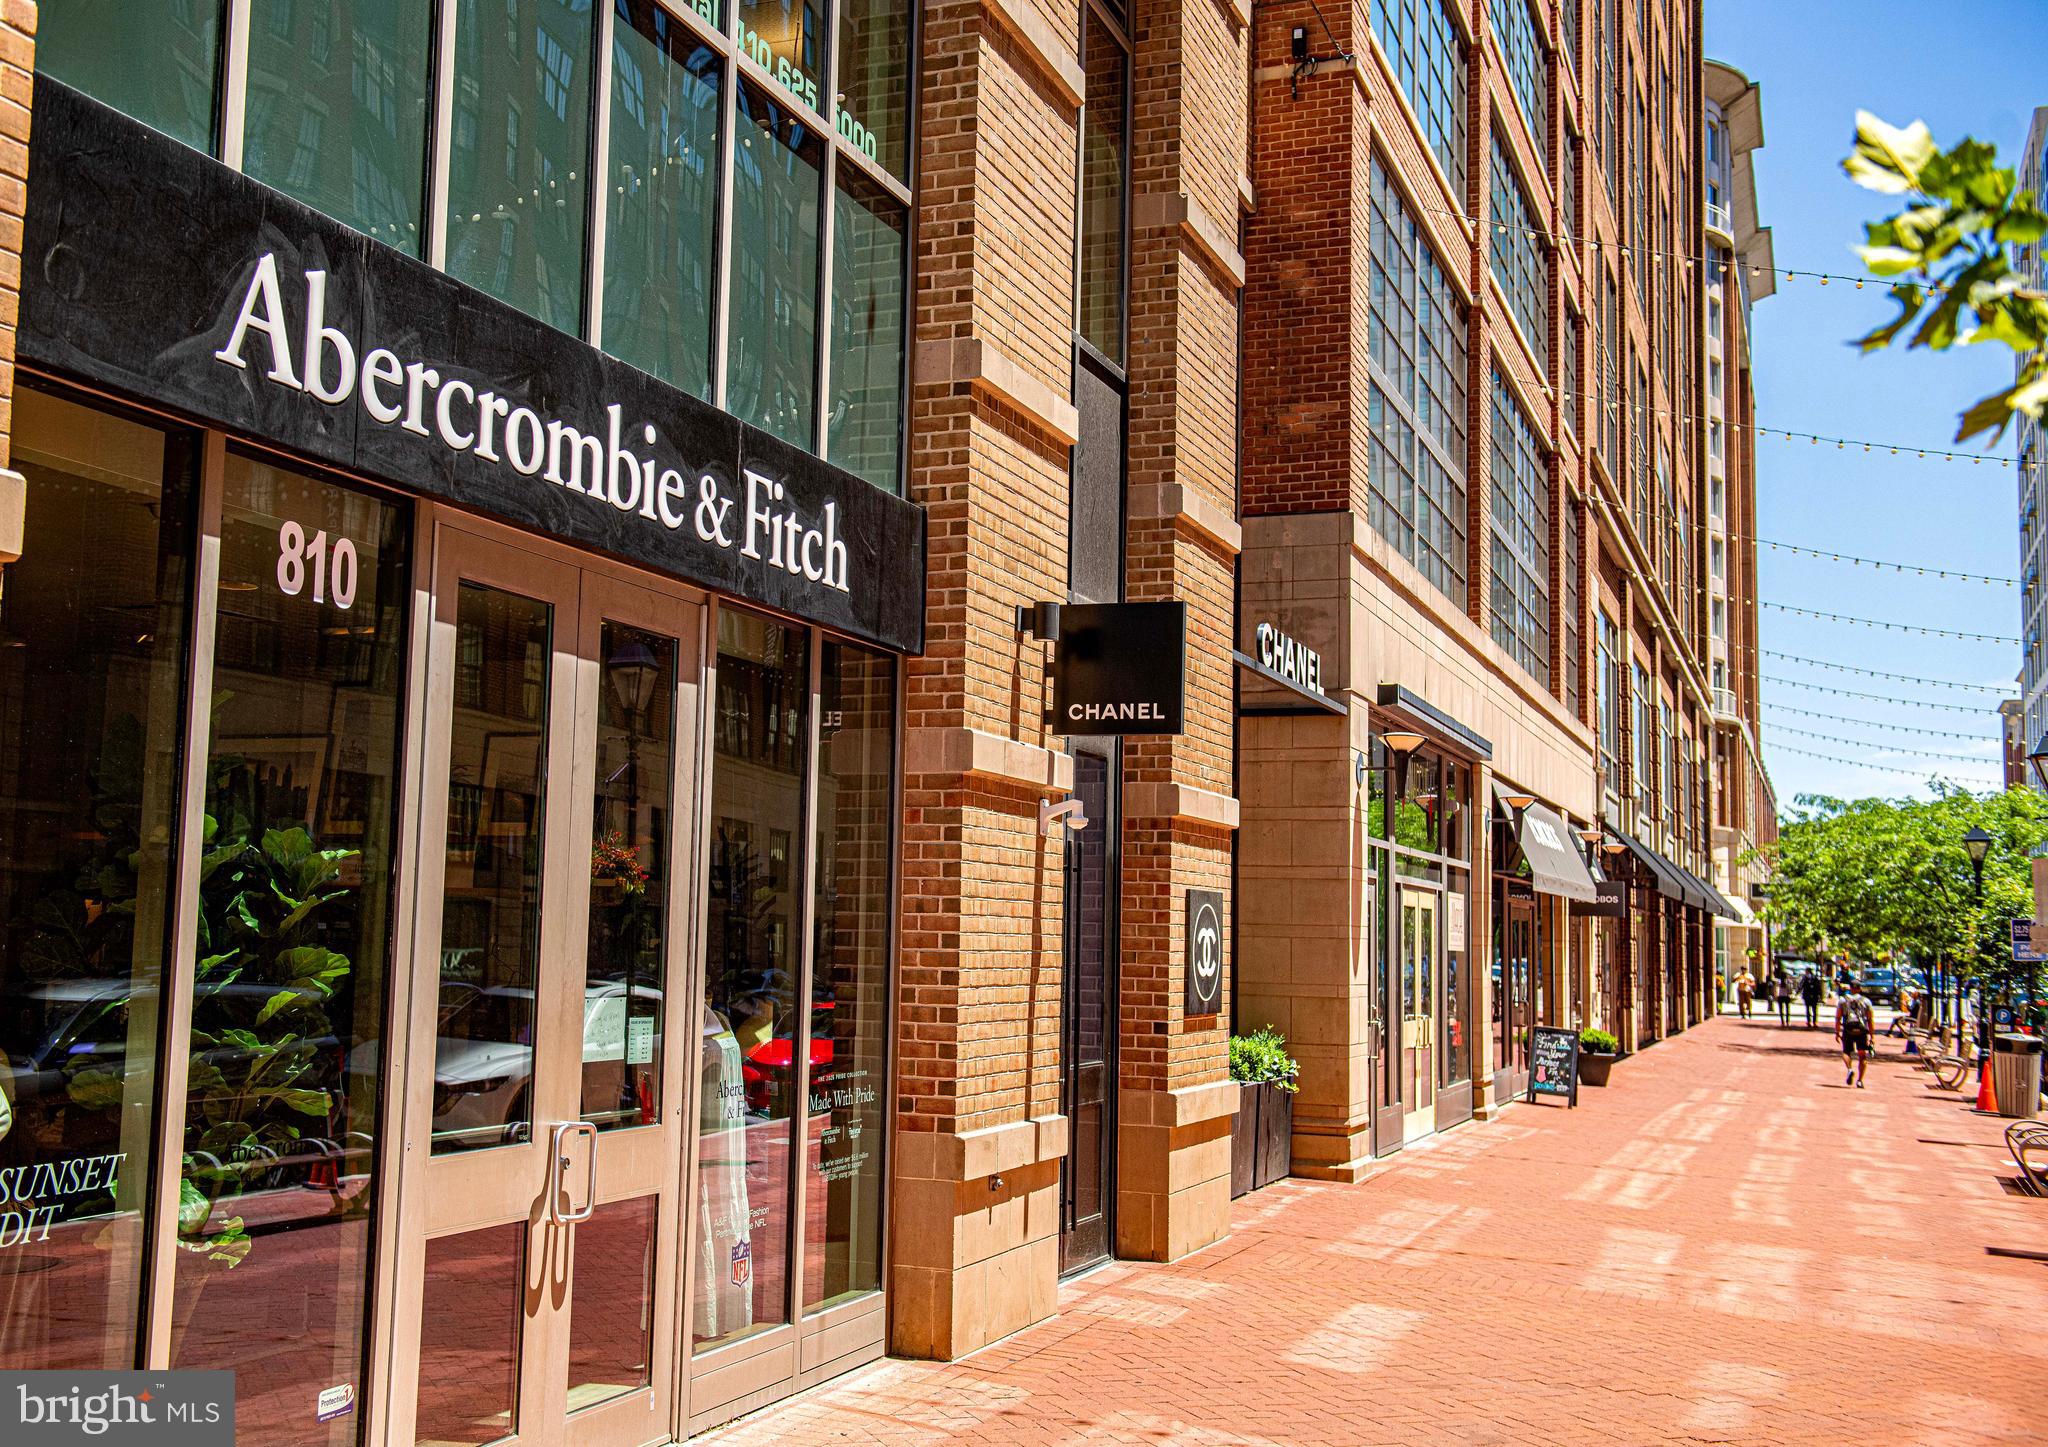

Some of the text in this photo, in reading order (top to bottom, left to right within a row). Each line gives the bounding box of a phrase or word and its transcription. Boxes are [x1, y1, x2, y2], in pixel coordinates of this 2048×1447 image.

[215, 252, 850, 593] Abercrombie & Fitch
[277, 520, 358, 610] 810
[1256, 622, 1325, 697] CHANEL
[1068, 703, 1166, 721] CHANEL
[809, 1084, 875, 1112] Made With Pride
[0, 1153, 127, 1205] SUNSET
[732, 1258, 748, 1281] NFL
